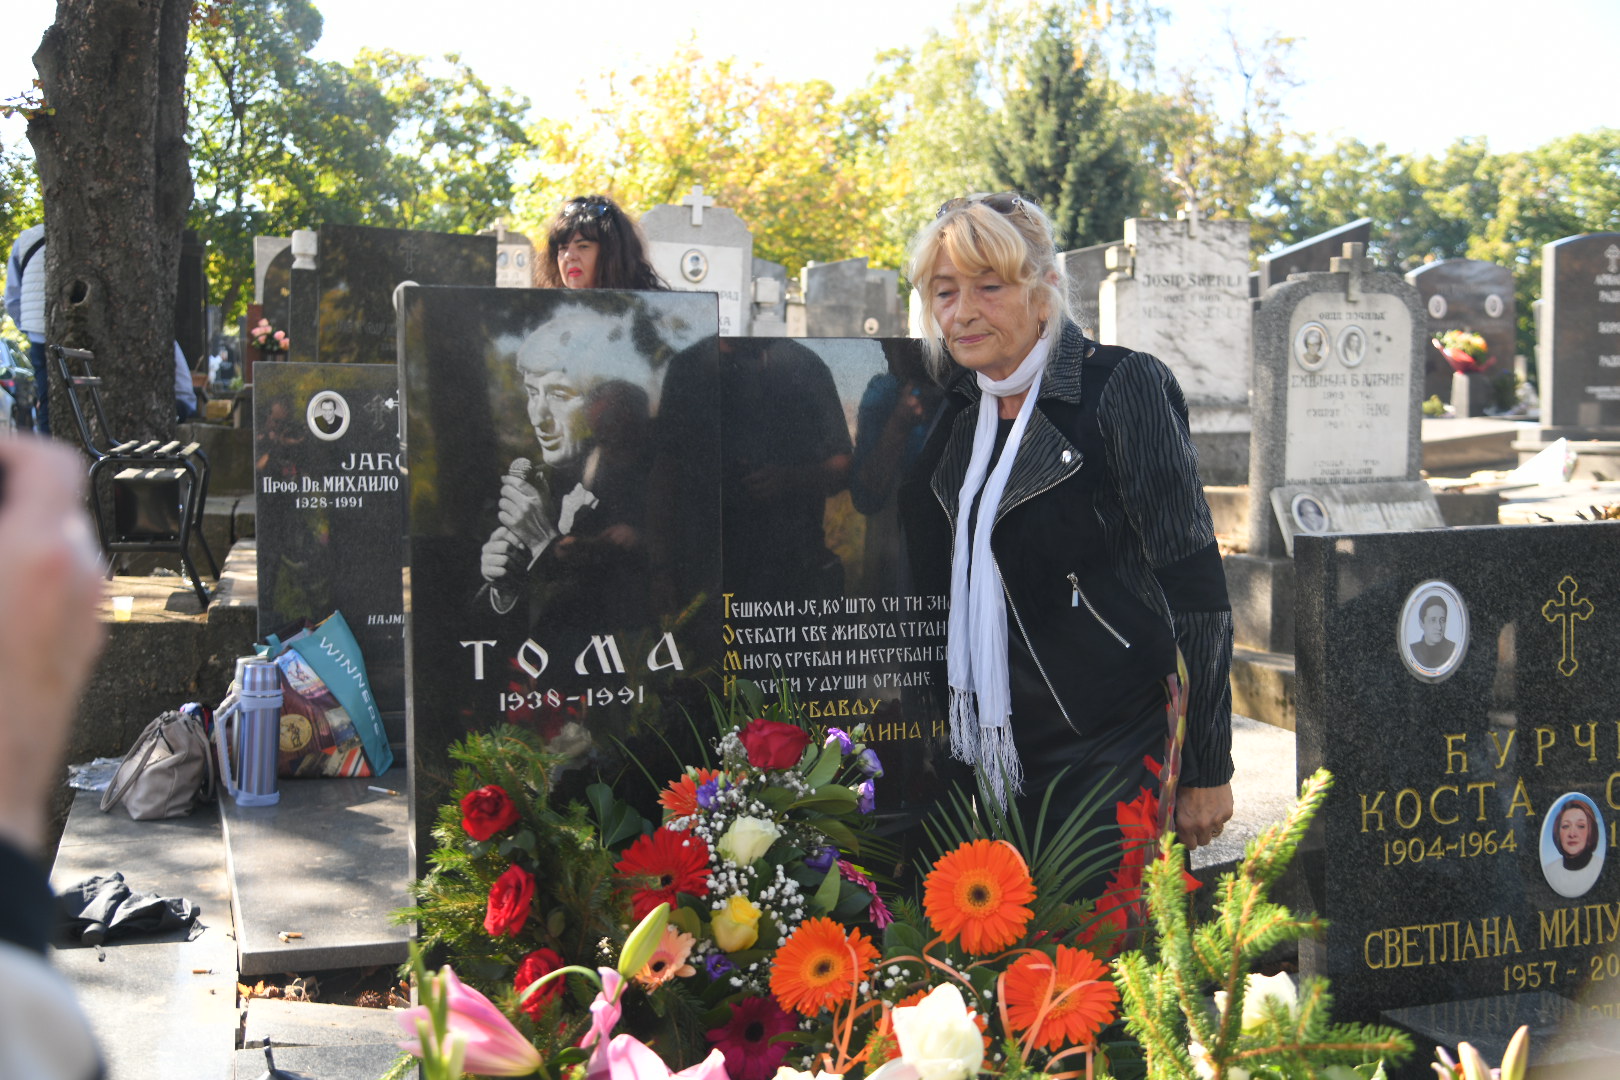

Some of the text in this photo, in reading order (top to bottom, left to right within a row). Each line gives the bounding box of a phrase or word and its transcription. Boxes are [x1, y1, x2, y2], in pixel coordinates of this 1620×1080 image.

[295, 496, 363, 508] 1928-1991
[881, 596, 899, 612] СИ
[903, 595, 923, 611] ТИ
[801, 625, 828, 642] СВЕ
[831, 622, 897, 641] ЖИВОТА
[899, 620, 949, 638] СТРАН
[459, 631, 684, 680] ТОМА
[723, 650, 782, 671] МНОГО
[846, 649, 856, 665] И
[806, 676, 818, 692] У
[819, 674, 867, 692] ДУШИ
[499, 685, 644, 712] 1938-1991
[778, 698, 882, 719] УБАВЉУ
[932, 720, 945, 738] И
[1442, 719, 1620, 775] ЋУРЧ
[1358, 776, 1536, 833] КОСТА
[1383, 828, 1518, 866] 1904-1964
[1364, 914, 1523, 970] СВЕТЛАНА
[1503, 960, 1558, 992] 1957
